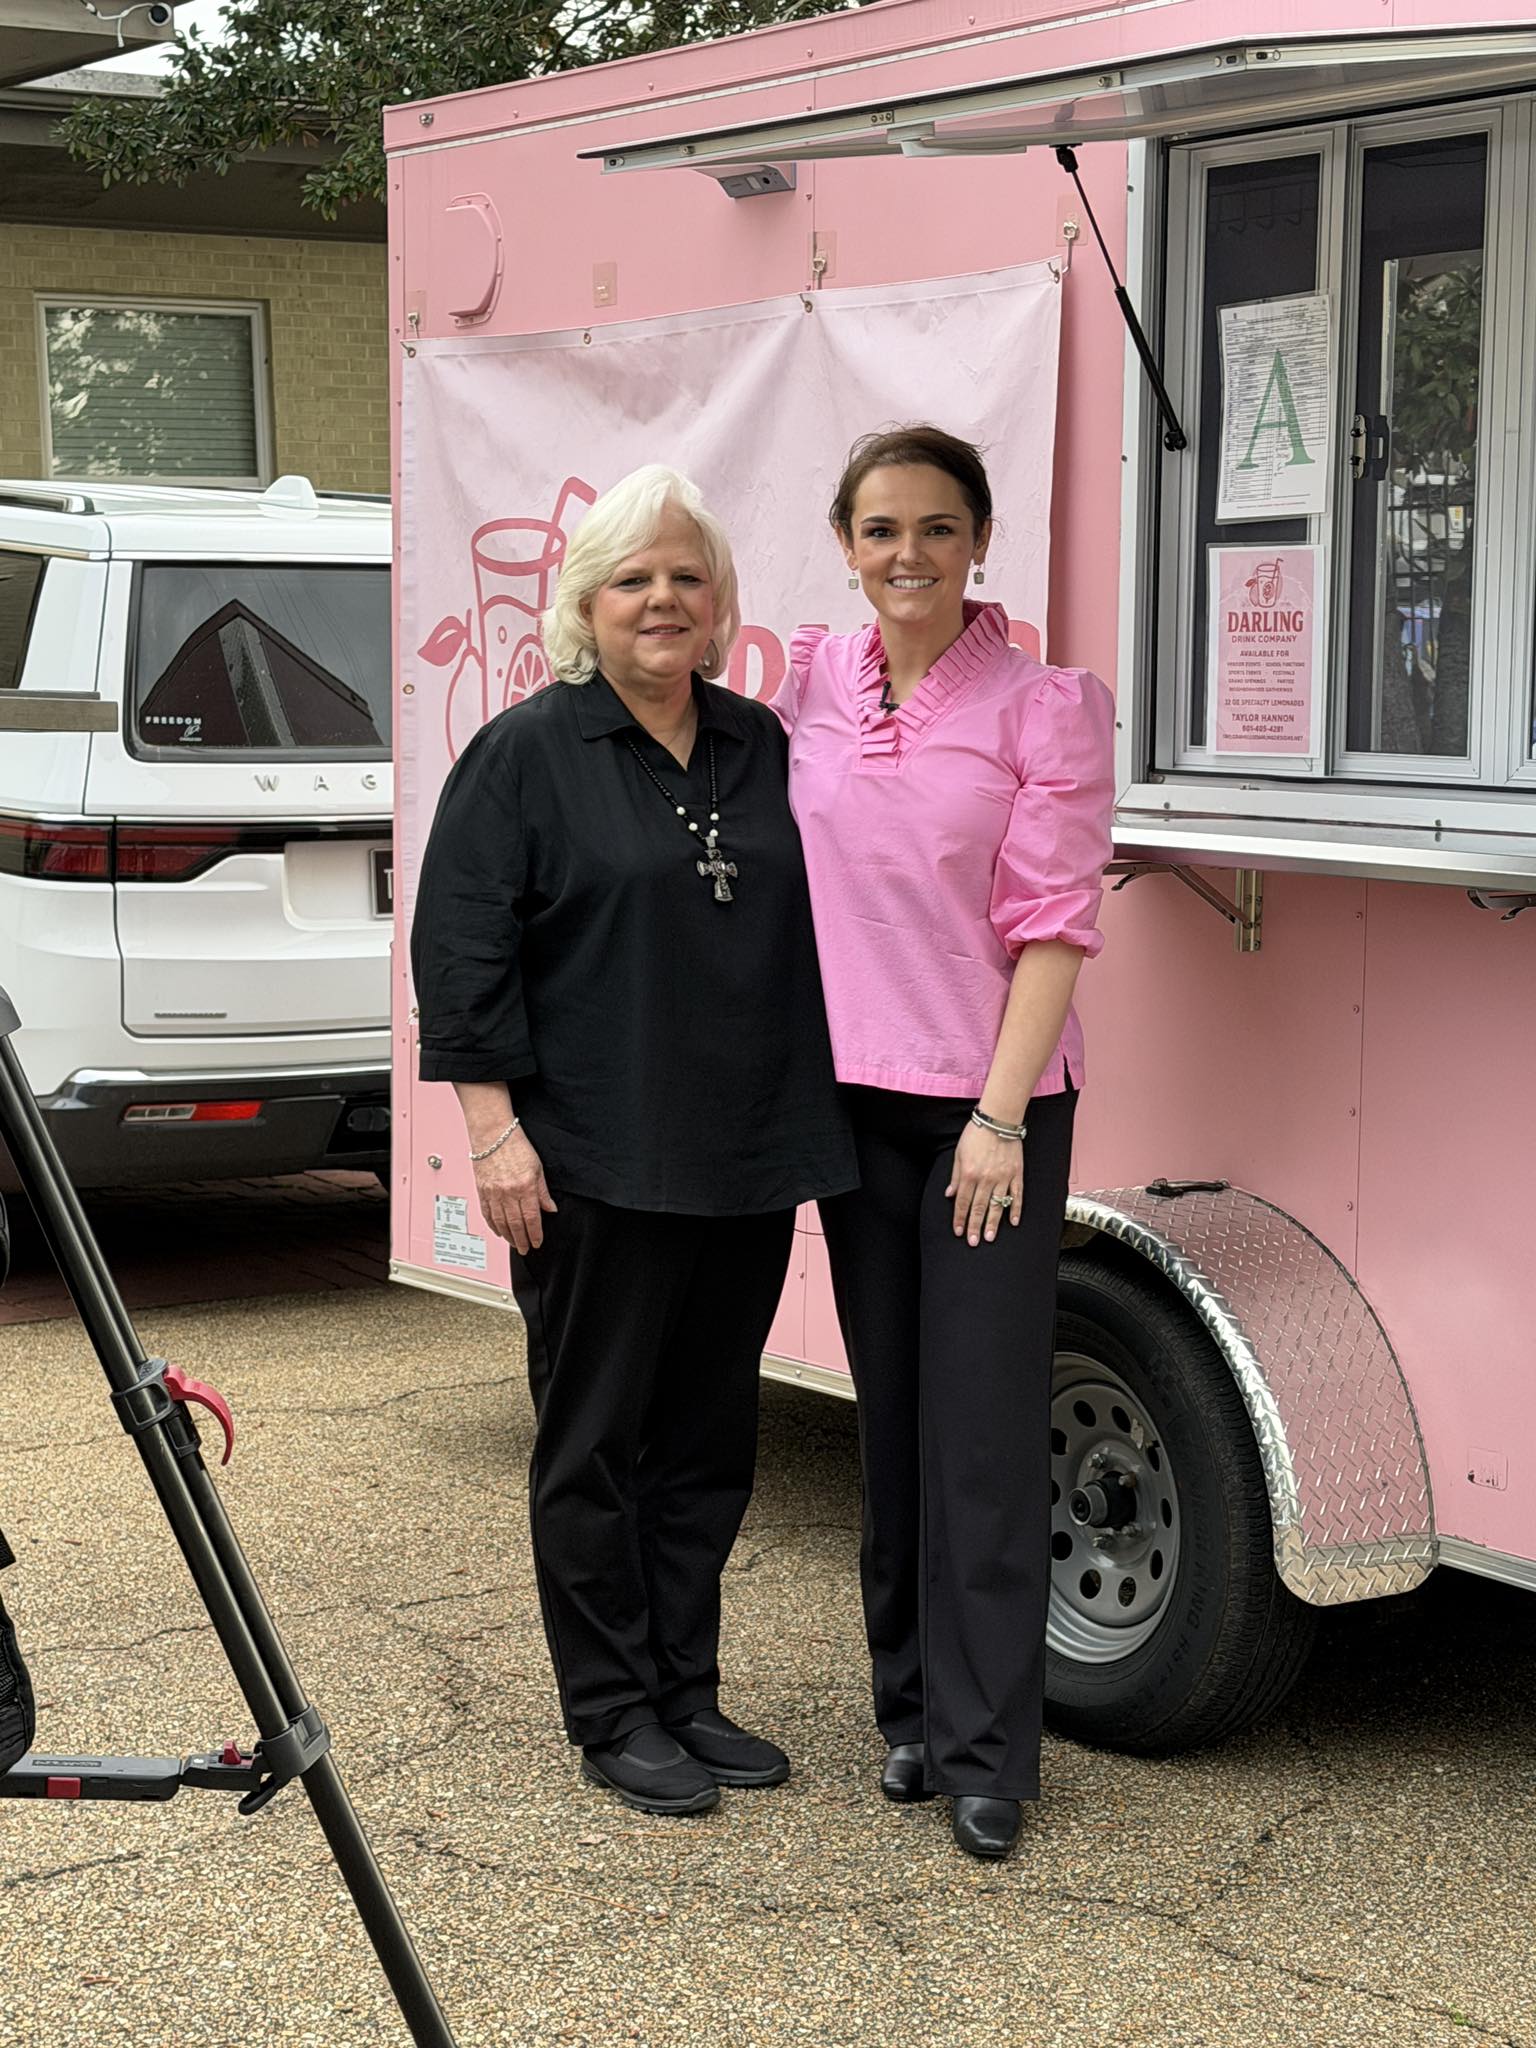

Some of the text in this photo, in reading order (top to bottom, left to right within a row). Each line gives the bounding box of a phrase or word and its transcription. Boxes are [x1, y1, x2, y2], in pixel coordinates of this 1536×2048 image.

[1236, 349, 1315, 470] A
[1228, 611, 1304, 632] DARLING
[1232, 635, 1297, 643] DRINK COMPANY
[145, 716, 202, 725] FREEDOM
[1232, 714, 1294, 722] TAYLOR HANNON
